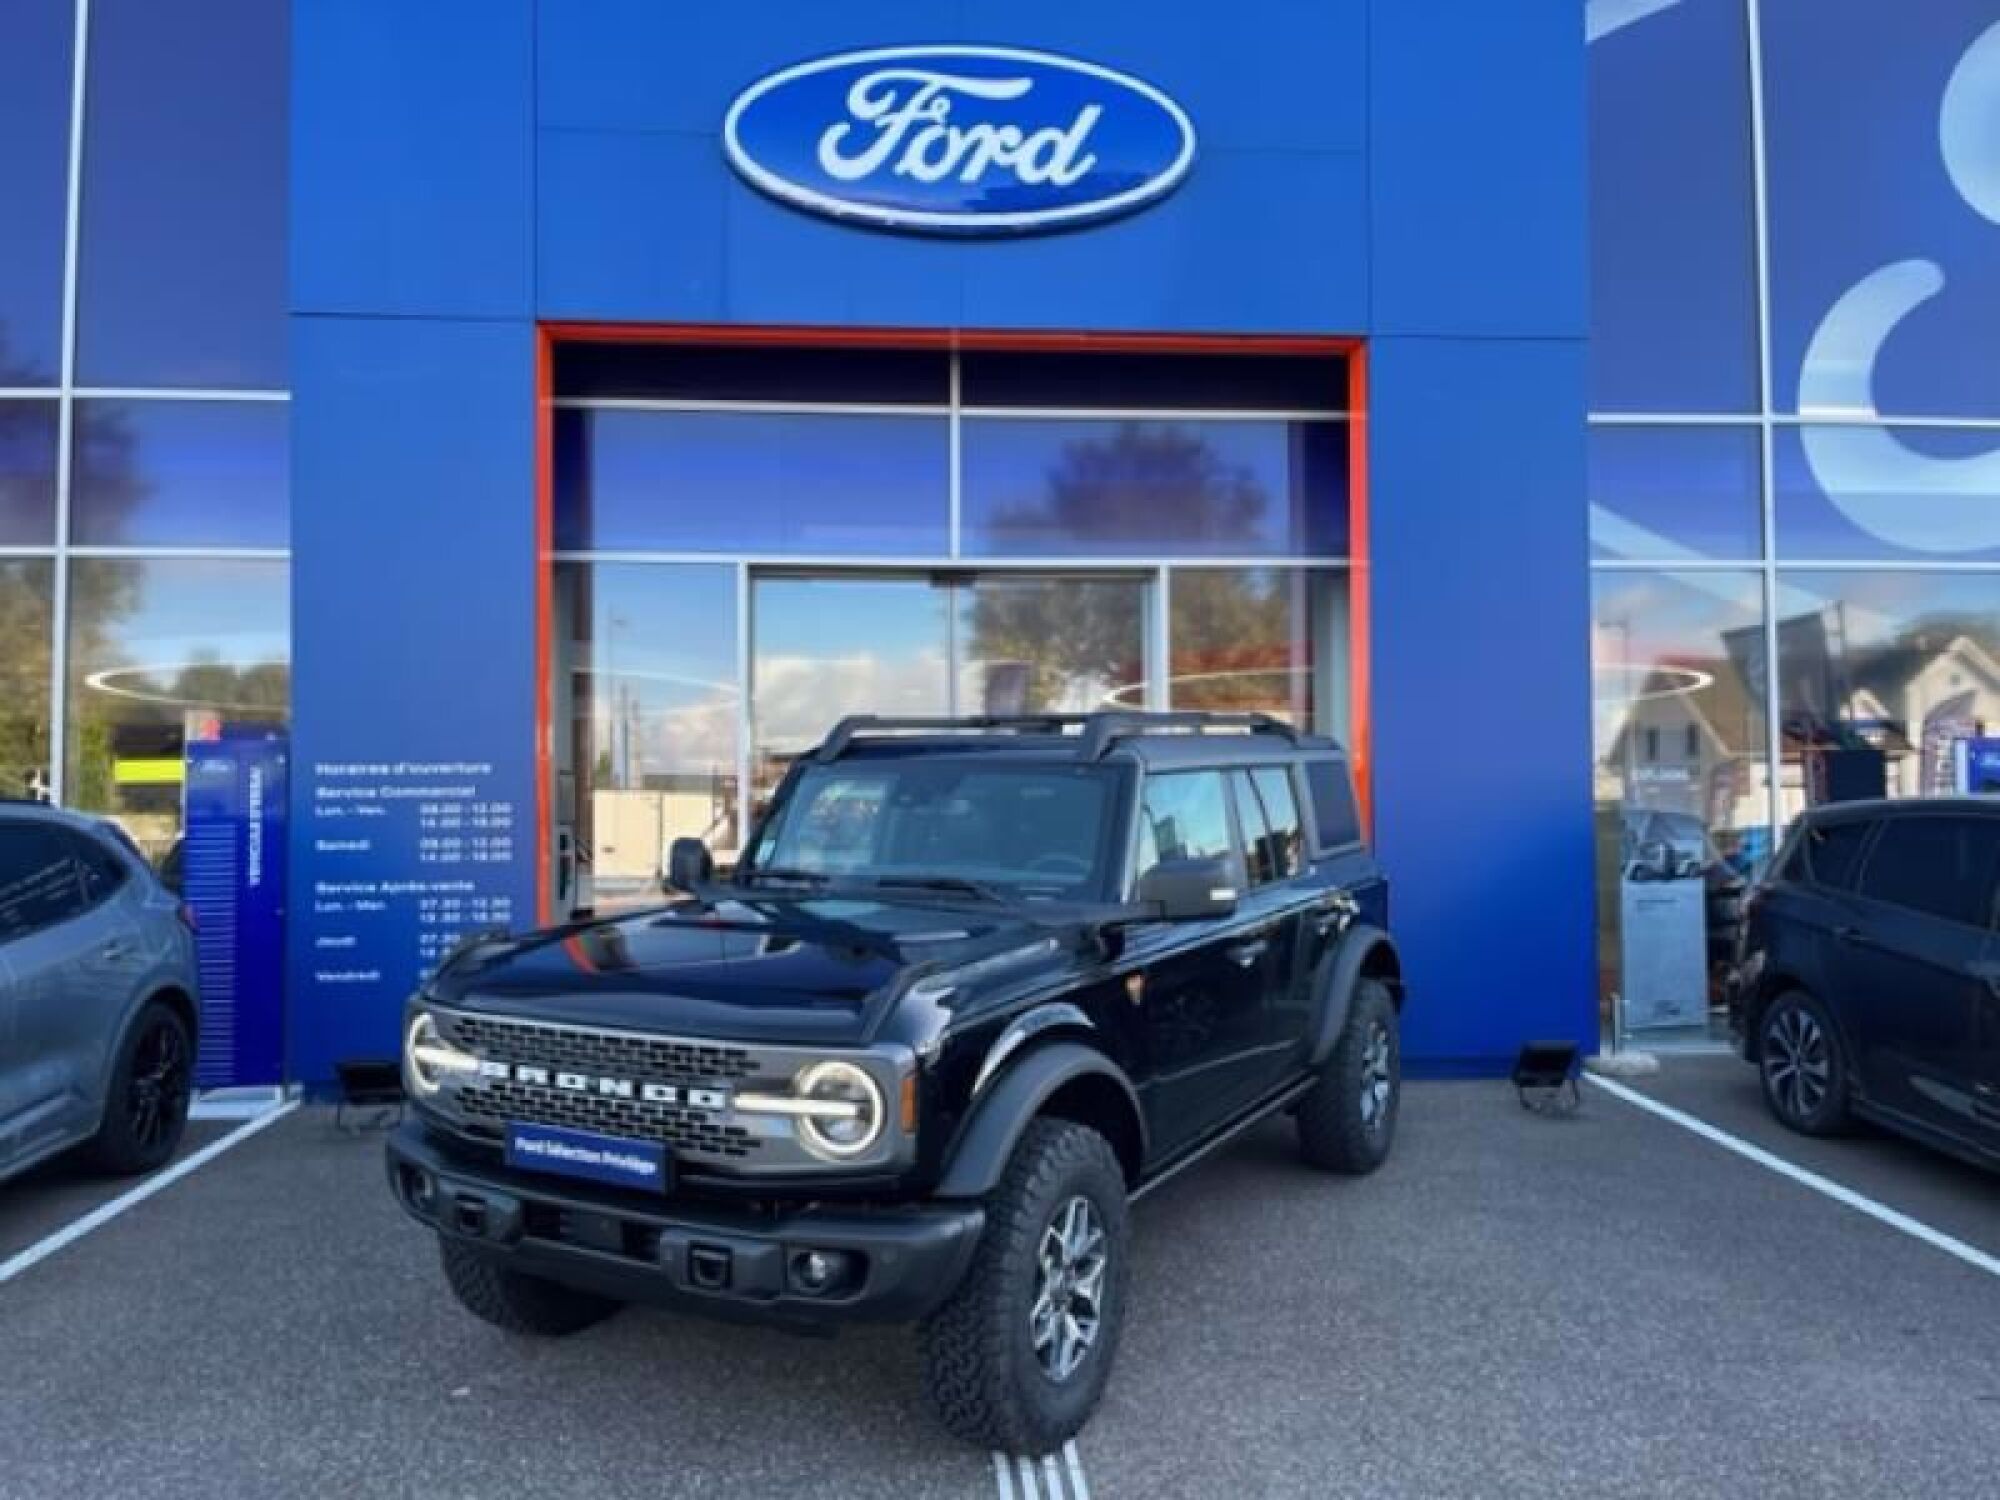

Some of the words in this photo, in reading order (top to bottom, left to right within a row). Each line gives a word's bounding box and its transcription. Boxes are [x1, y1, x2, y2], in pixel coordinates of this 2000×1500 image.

[818, 69, 1103, 187] Ford
[315, 762, 389, 776] Horaires
[393, 761, 492, 776] d'ouverture
[315, 784, 376, 799] Service
[380, 784, 475, 798] Commercial
[315, 838, 371, 851] Samedi
[315, 878, 376, 894] Service
[315, 968, 382, 981] Vendredi
[479, 1060, 726, 1108] BRONCO
[514, 1136, 545, 1154] Ford
